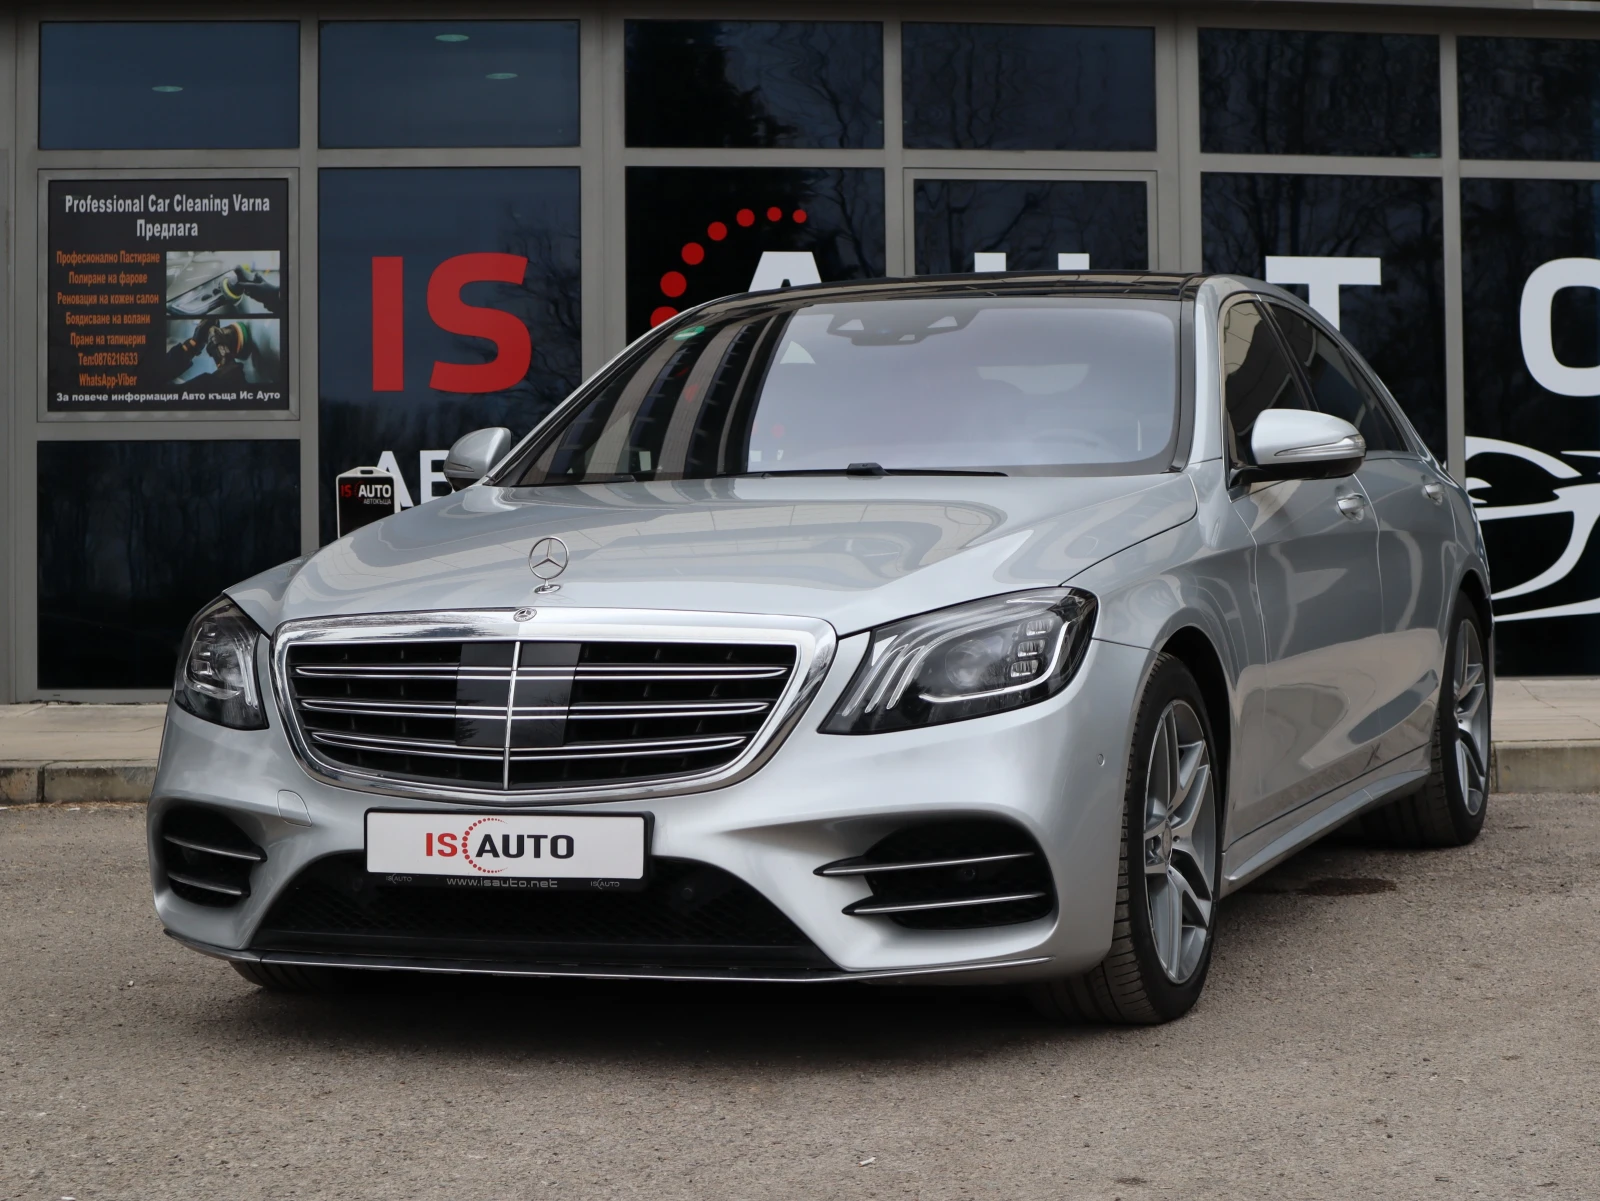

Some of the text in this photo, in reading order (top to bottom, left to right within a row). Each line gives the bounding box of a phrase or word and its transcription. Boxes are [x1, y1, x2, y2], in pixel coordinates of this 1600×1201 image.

[65, 194, 270, 216] Professional Car Cleaning Varna
[136, 219, 198, 241] Предлага
[56, 251, 118, 267] Професионално
[69, 270, 148, 287] Полиране на фарове
[57, 291, 159, 306] Реновация на кожен салон
[65, 311, 151, 326] Боядисване на волани
[371, 252, 532, 394] IS
[70, 332, 146, 348] Пране на тапицерия
[79, 373, 138, 389] WhatsApp-Viber
[56, 390, 281, 403] За повече информация Авто къща Ис Ауто
[340, 484, 392, 498] IS AUTO
[425, 832, 575, 859] IS AUTO
[446, 877, 558, 888] www.isauto.net
